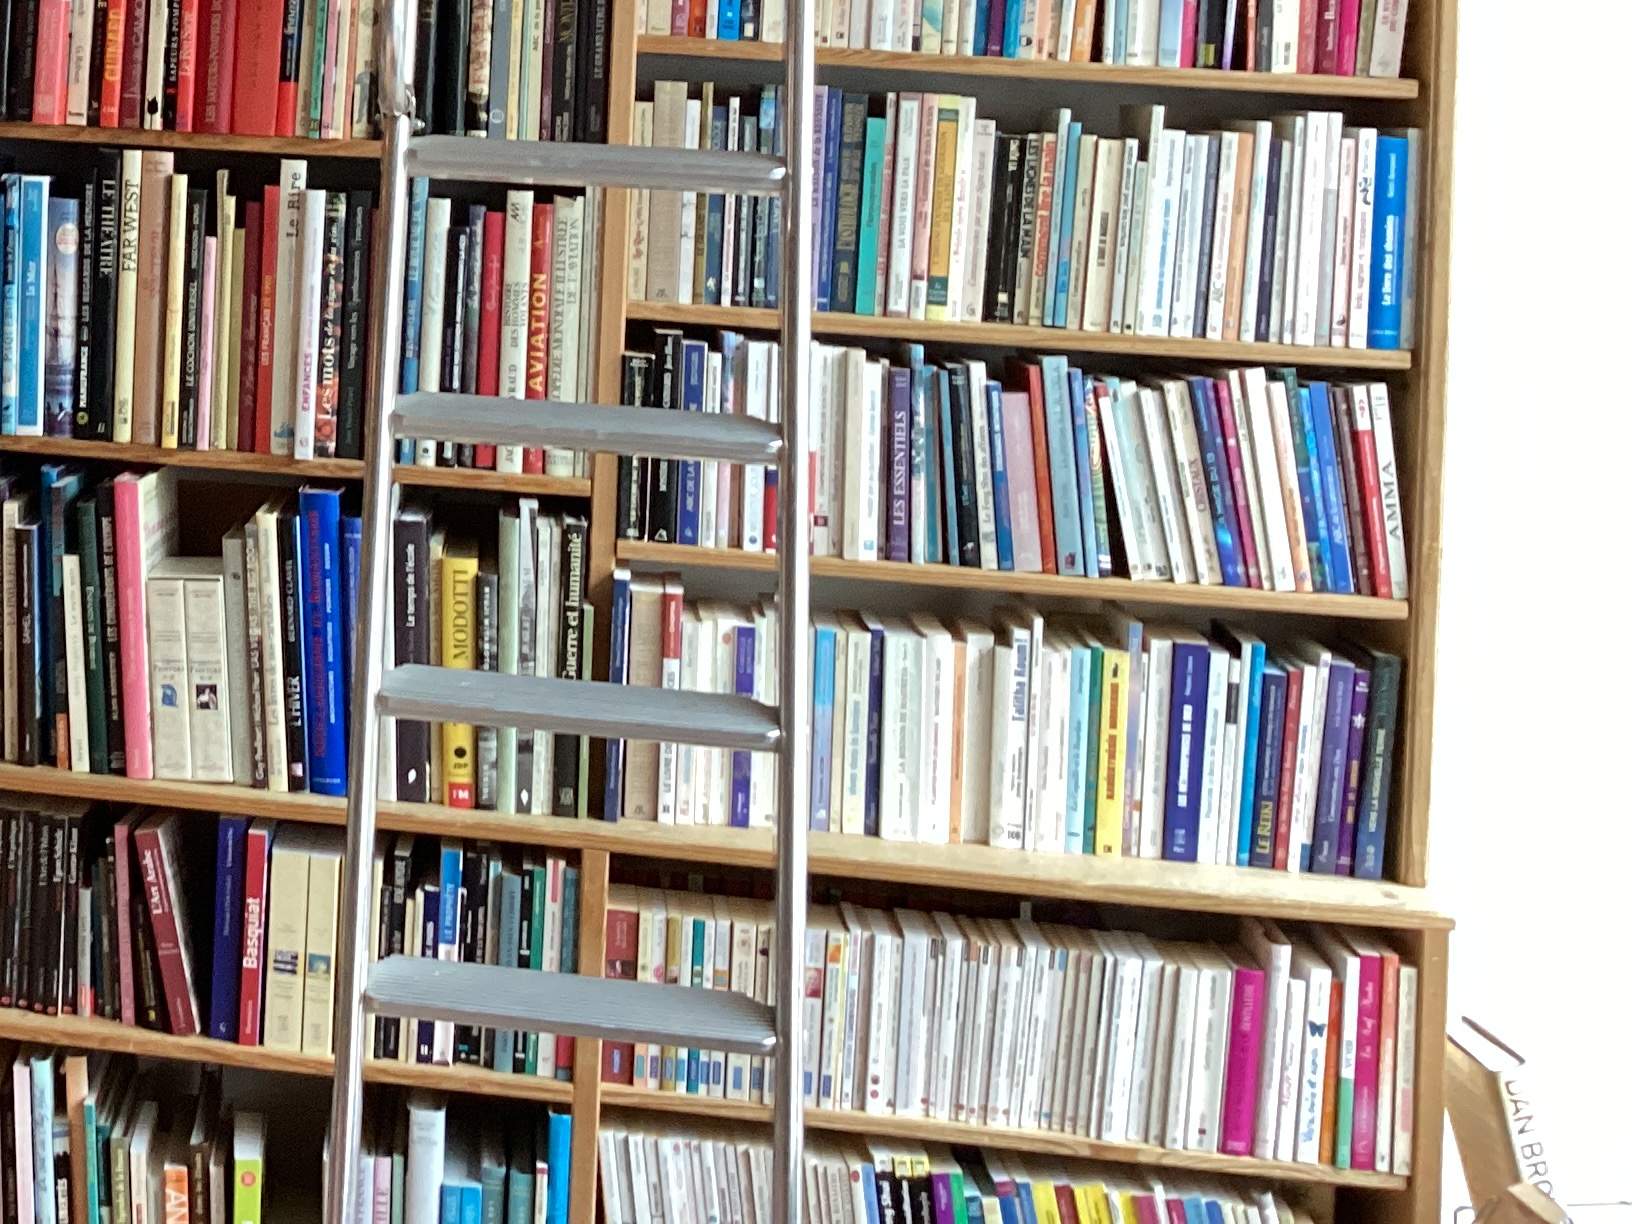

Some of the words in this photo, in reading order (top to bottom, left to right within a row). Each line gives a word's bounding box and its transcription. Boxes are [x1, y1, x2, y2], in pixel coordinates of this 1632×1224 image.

[1028, 138, 1039, 160] LES
[101, 179, 116, 200] LE
[122, 179, 138, 232] WEST
[287, 172, 301, 211] Rire
[286, 218, 300, 239] Le
[1021, 212, 1033, 226] LA
[121, 238, 136, 272] FAR
[1020, 228, 1033, 258] MAIN
[187, 281, 197, 331] UNIVERSEL
[502, 282, 512, 327] HISTOIRE
[511, 281, 520, 327] HOMMES
[567, 285, 577, 304] DE
[528, 273, 547, 392] AVIATION
[553, 286, 566, 350] MONDIALE
[186, 333, 196, 374] COCHON
[510, 329, 519, 348] DES
[321, 338, 335, 385] mots
[185, 375, 194, 386] LE
[302, 352, 312, 412] ENFANCES
[316, 388, 334, 419] Les
[893, 409, 907, 496] ESSENTIELS
[893, 499, 906, 525] LES
[1380, 459, 1401, 541] AMMA
[405, 543, 417, 572] l'école
[565, 532, 583, 605] humanité
[406, 573, 416, 585] de
[406, 586, 418, 614] temps
[451, 569, 470, 661] MODOTTI
[564, 607, 579, 625] et
[22, 613, 31, 644] SAHEL
[405, 616, 416, 627] Le
[558, 627, 579, 681] Guerre
[287, 675, 302, 727] L'HIVER
[142, 849, 158, 883] Arabe
[148, 886, 164, 915] L'Art
[242, 897, 263, 969] Basquiat
[1503, 1078, 1533, 1136] DAN
